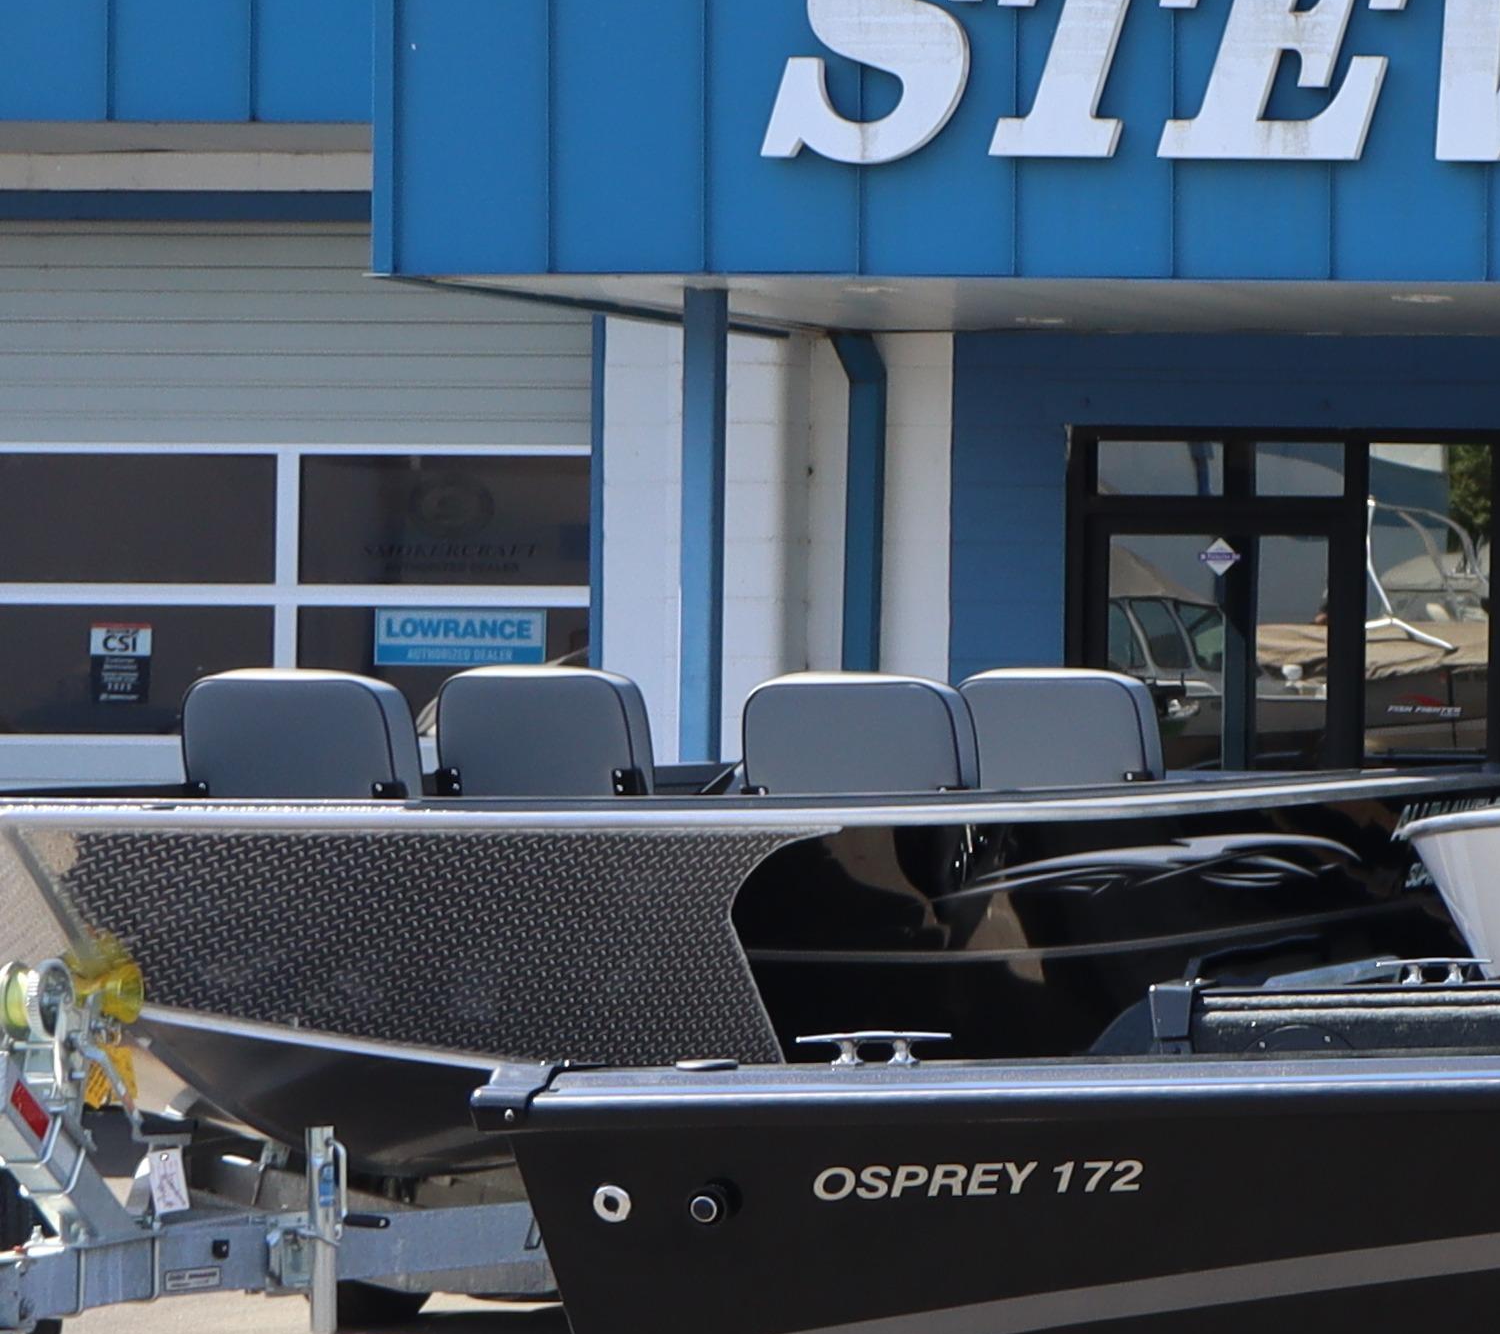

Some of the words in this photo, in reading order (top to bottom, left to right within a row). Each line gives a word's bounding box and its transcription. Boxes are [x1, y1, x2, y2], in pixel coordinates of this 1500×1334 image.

[385, 617, 532, 640] LOWRANCE
[102, 634, 138, 653] CSI
[406, 647, 471, 662] AUTHORIZED
[473, 647, 514, 662] DEALER
[813, 1161, 1038, 1201] OSPREY
[1052, 1159, 1144, 1194] 172
